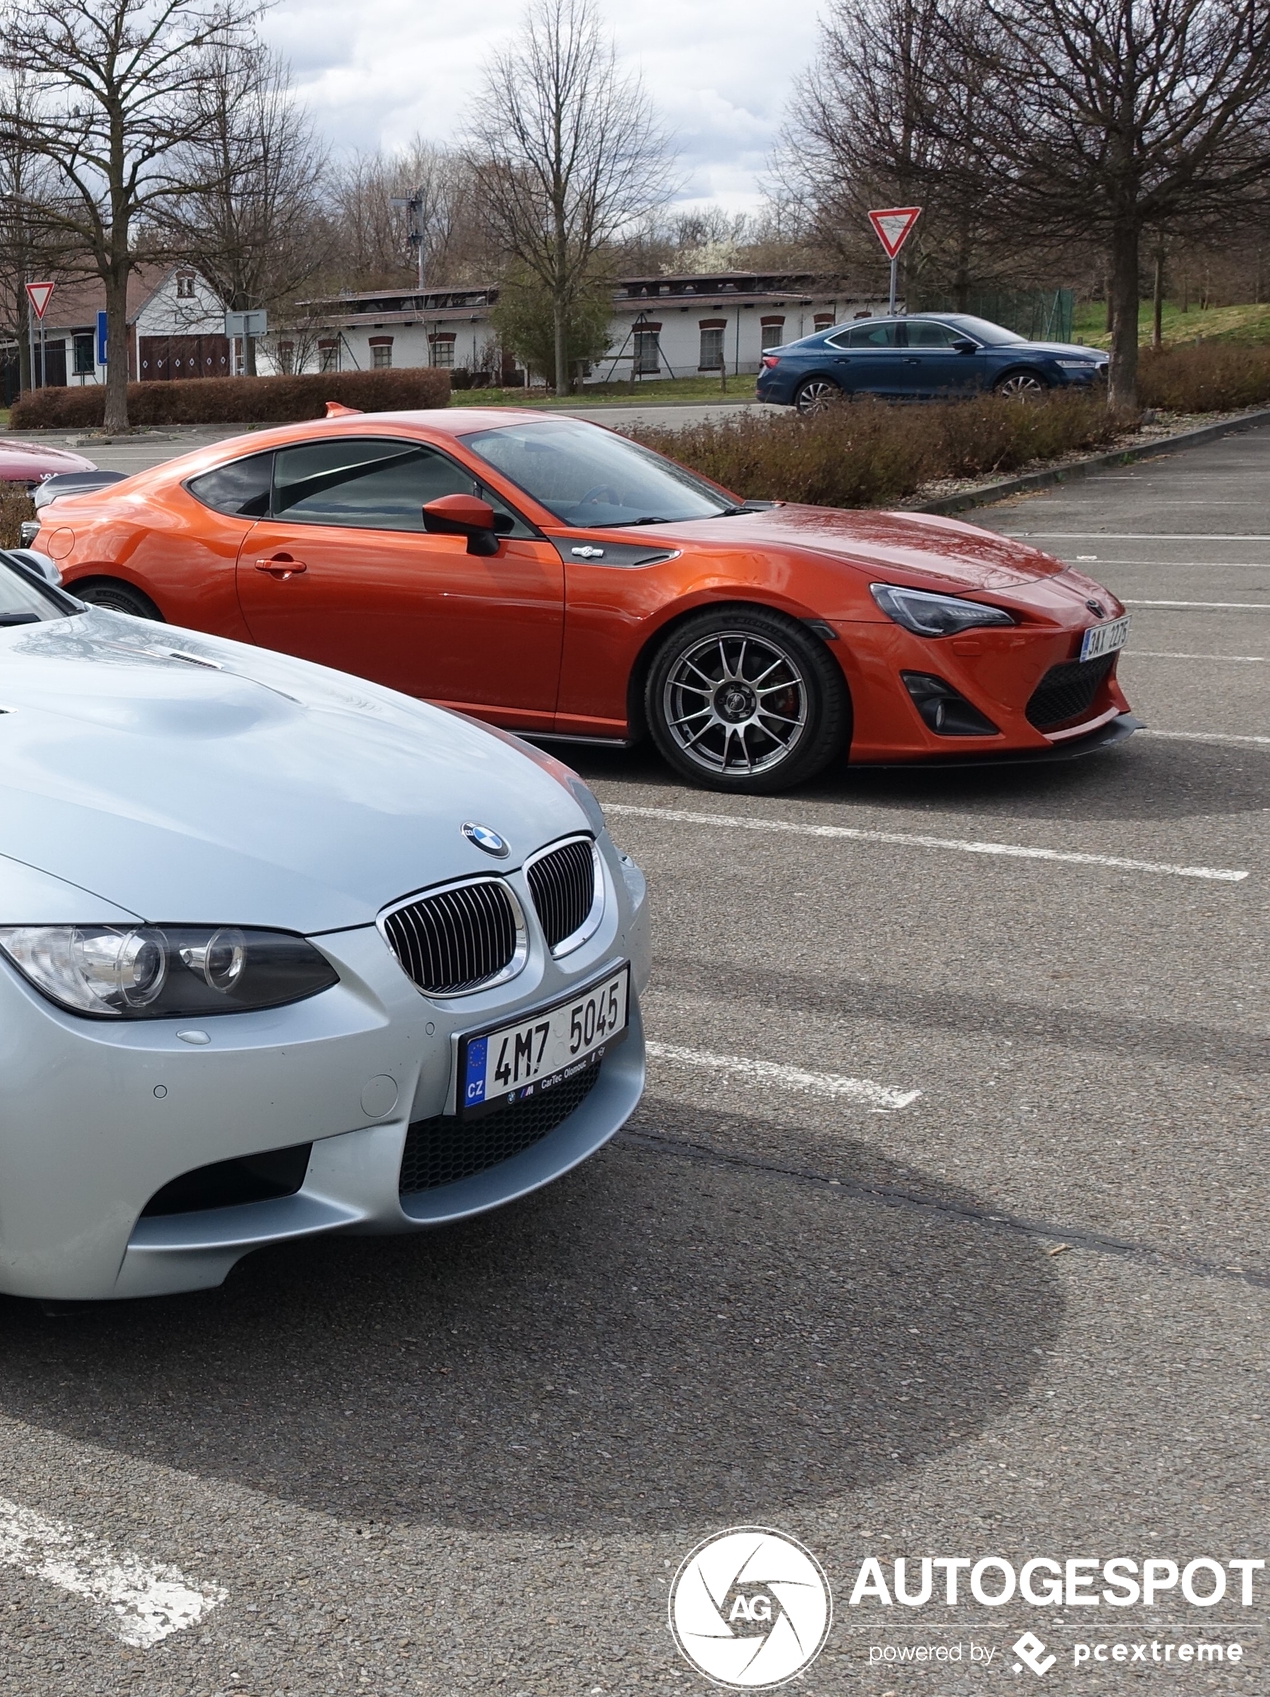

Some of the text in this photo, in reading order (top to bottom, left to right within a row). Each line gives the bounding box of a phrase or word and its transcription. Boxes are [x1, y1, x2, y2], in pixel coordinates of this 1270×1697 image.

[494, 982, 619, 1086] 4M7 5045
[467, 1080, 483, 1099] CZ
[541, 1073, 562, 1090] CarTec
[564, 1060, 587, 1078] Olomouc
